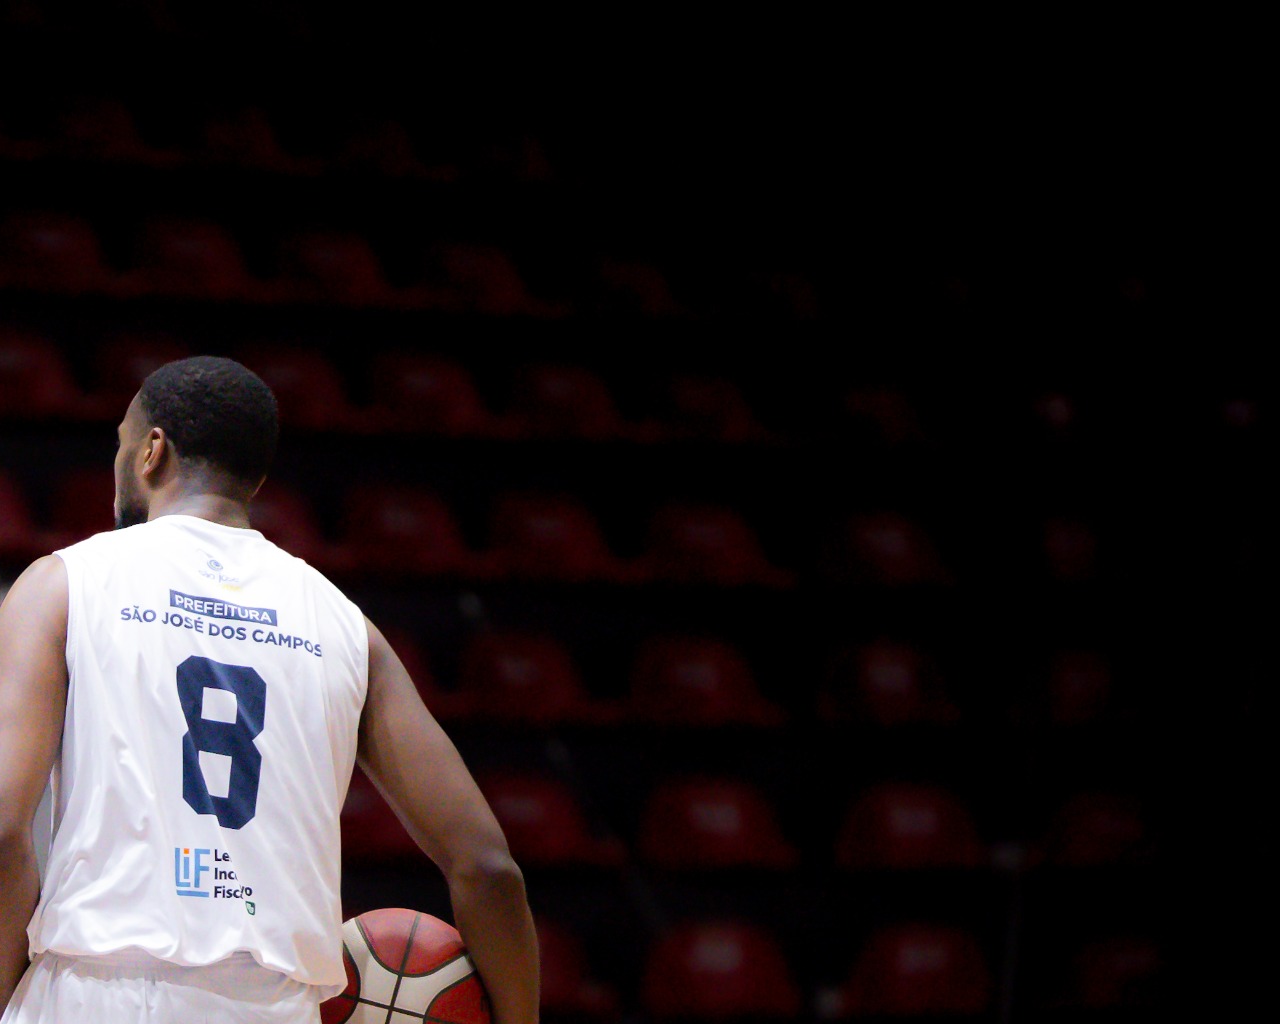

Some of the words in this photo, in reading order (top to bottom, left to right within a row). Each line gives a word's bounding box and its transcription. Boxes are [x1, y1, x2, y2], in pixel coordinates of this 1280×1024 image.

[175, 594, 272, 623] PREFEITURA
[120, 605, 157, 623] SÃO
[162, 612, 205, 633] JOSÉ
[208, 624, 247, 640] DOS
[252, 629, 323, 657] CAMPOS
[176, 655, 267, 830] 8
[214, 849, 231, 862] Le
[214, 867, 238, 881] Inc
